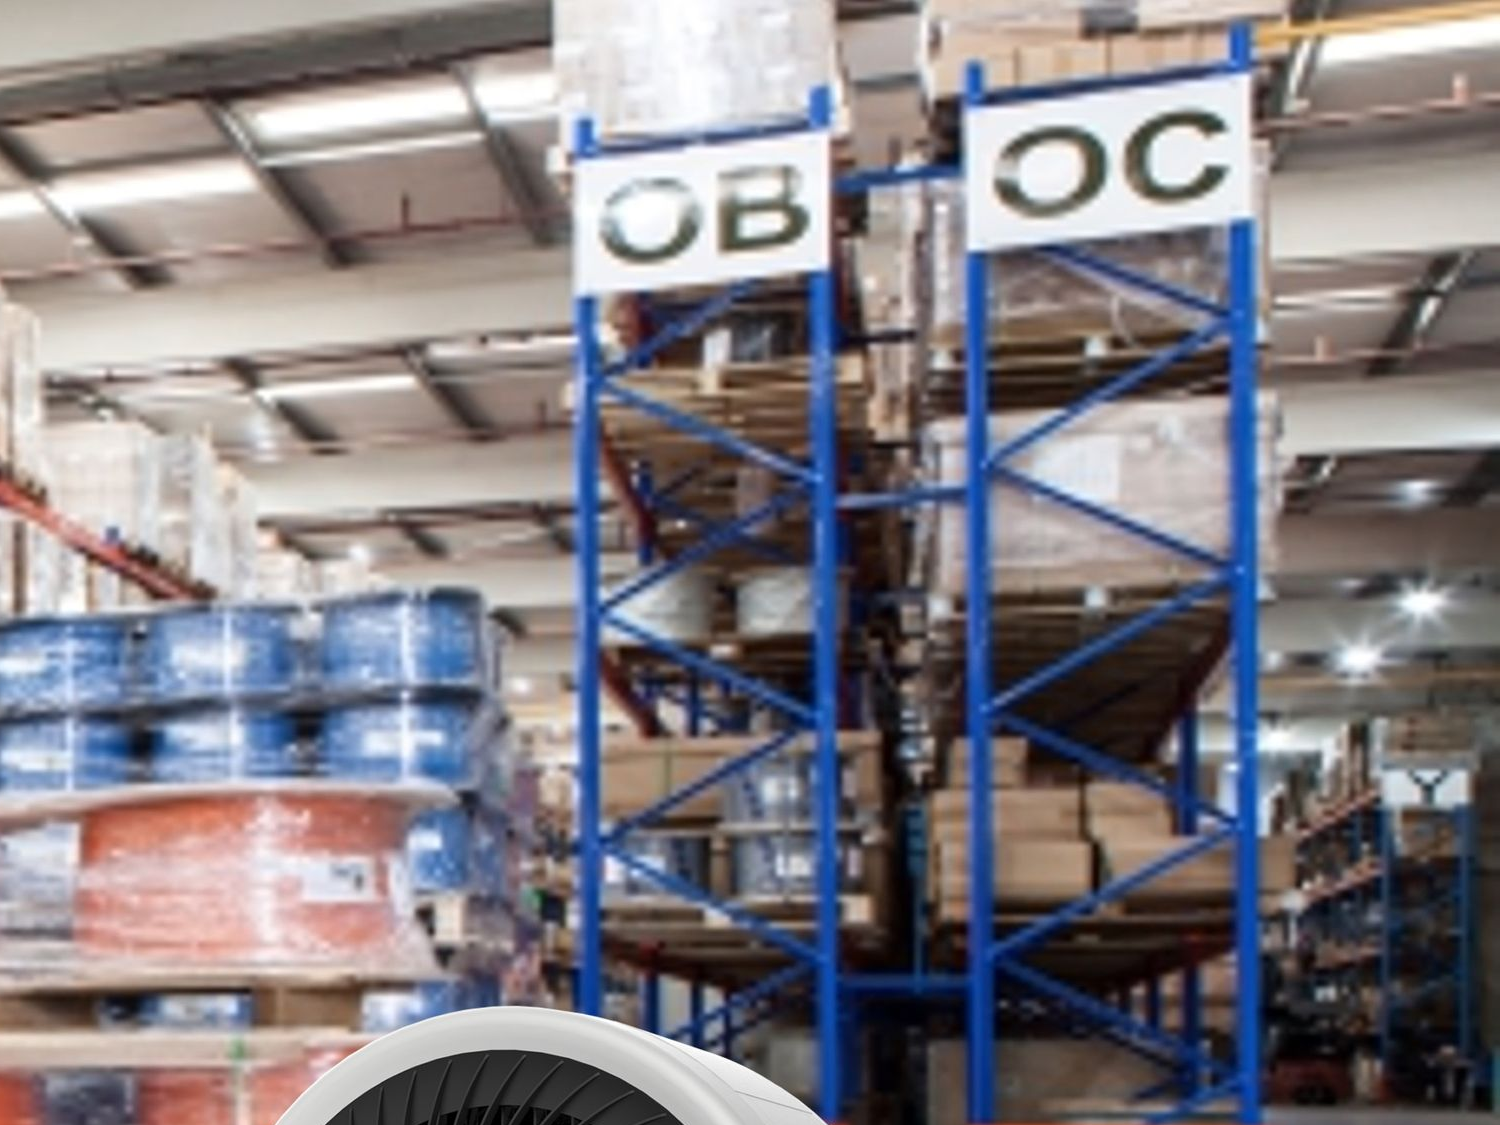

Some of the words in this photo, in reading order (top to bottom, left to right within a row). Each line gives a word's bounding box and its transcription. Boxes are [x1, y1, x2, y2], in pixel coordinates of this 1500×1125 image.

[993, 110, 1230, 218] OC
[599, 165, 811, 263] OB
[1408, 768, 1449, 804] Y
